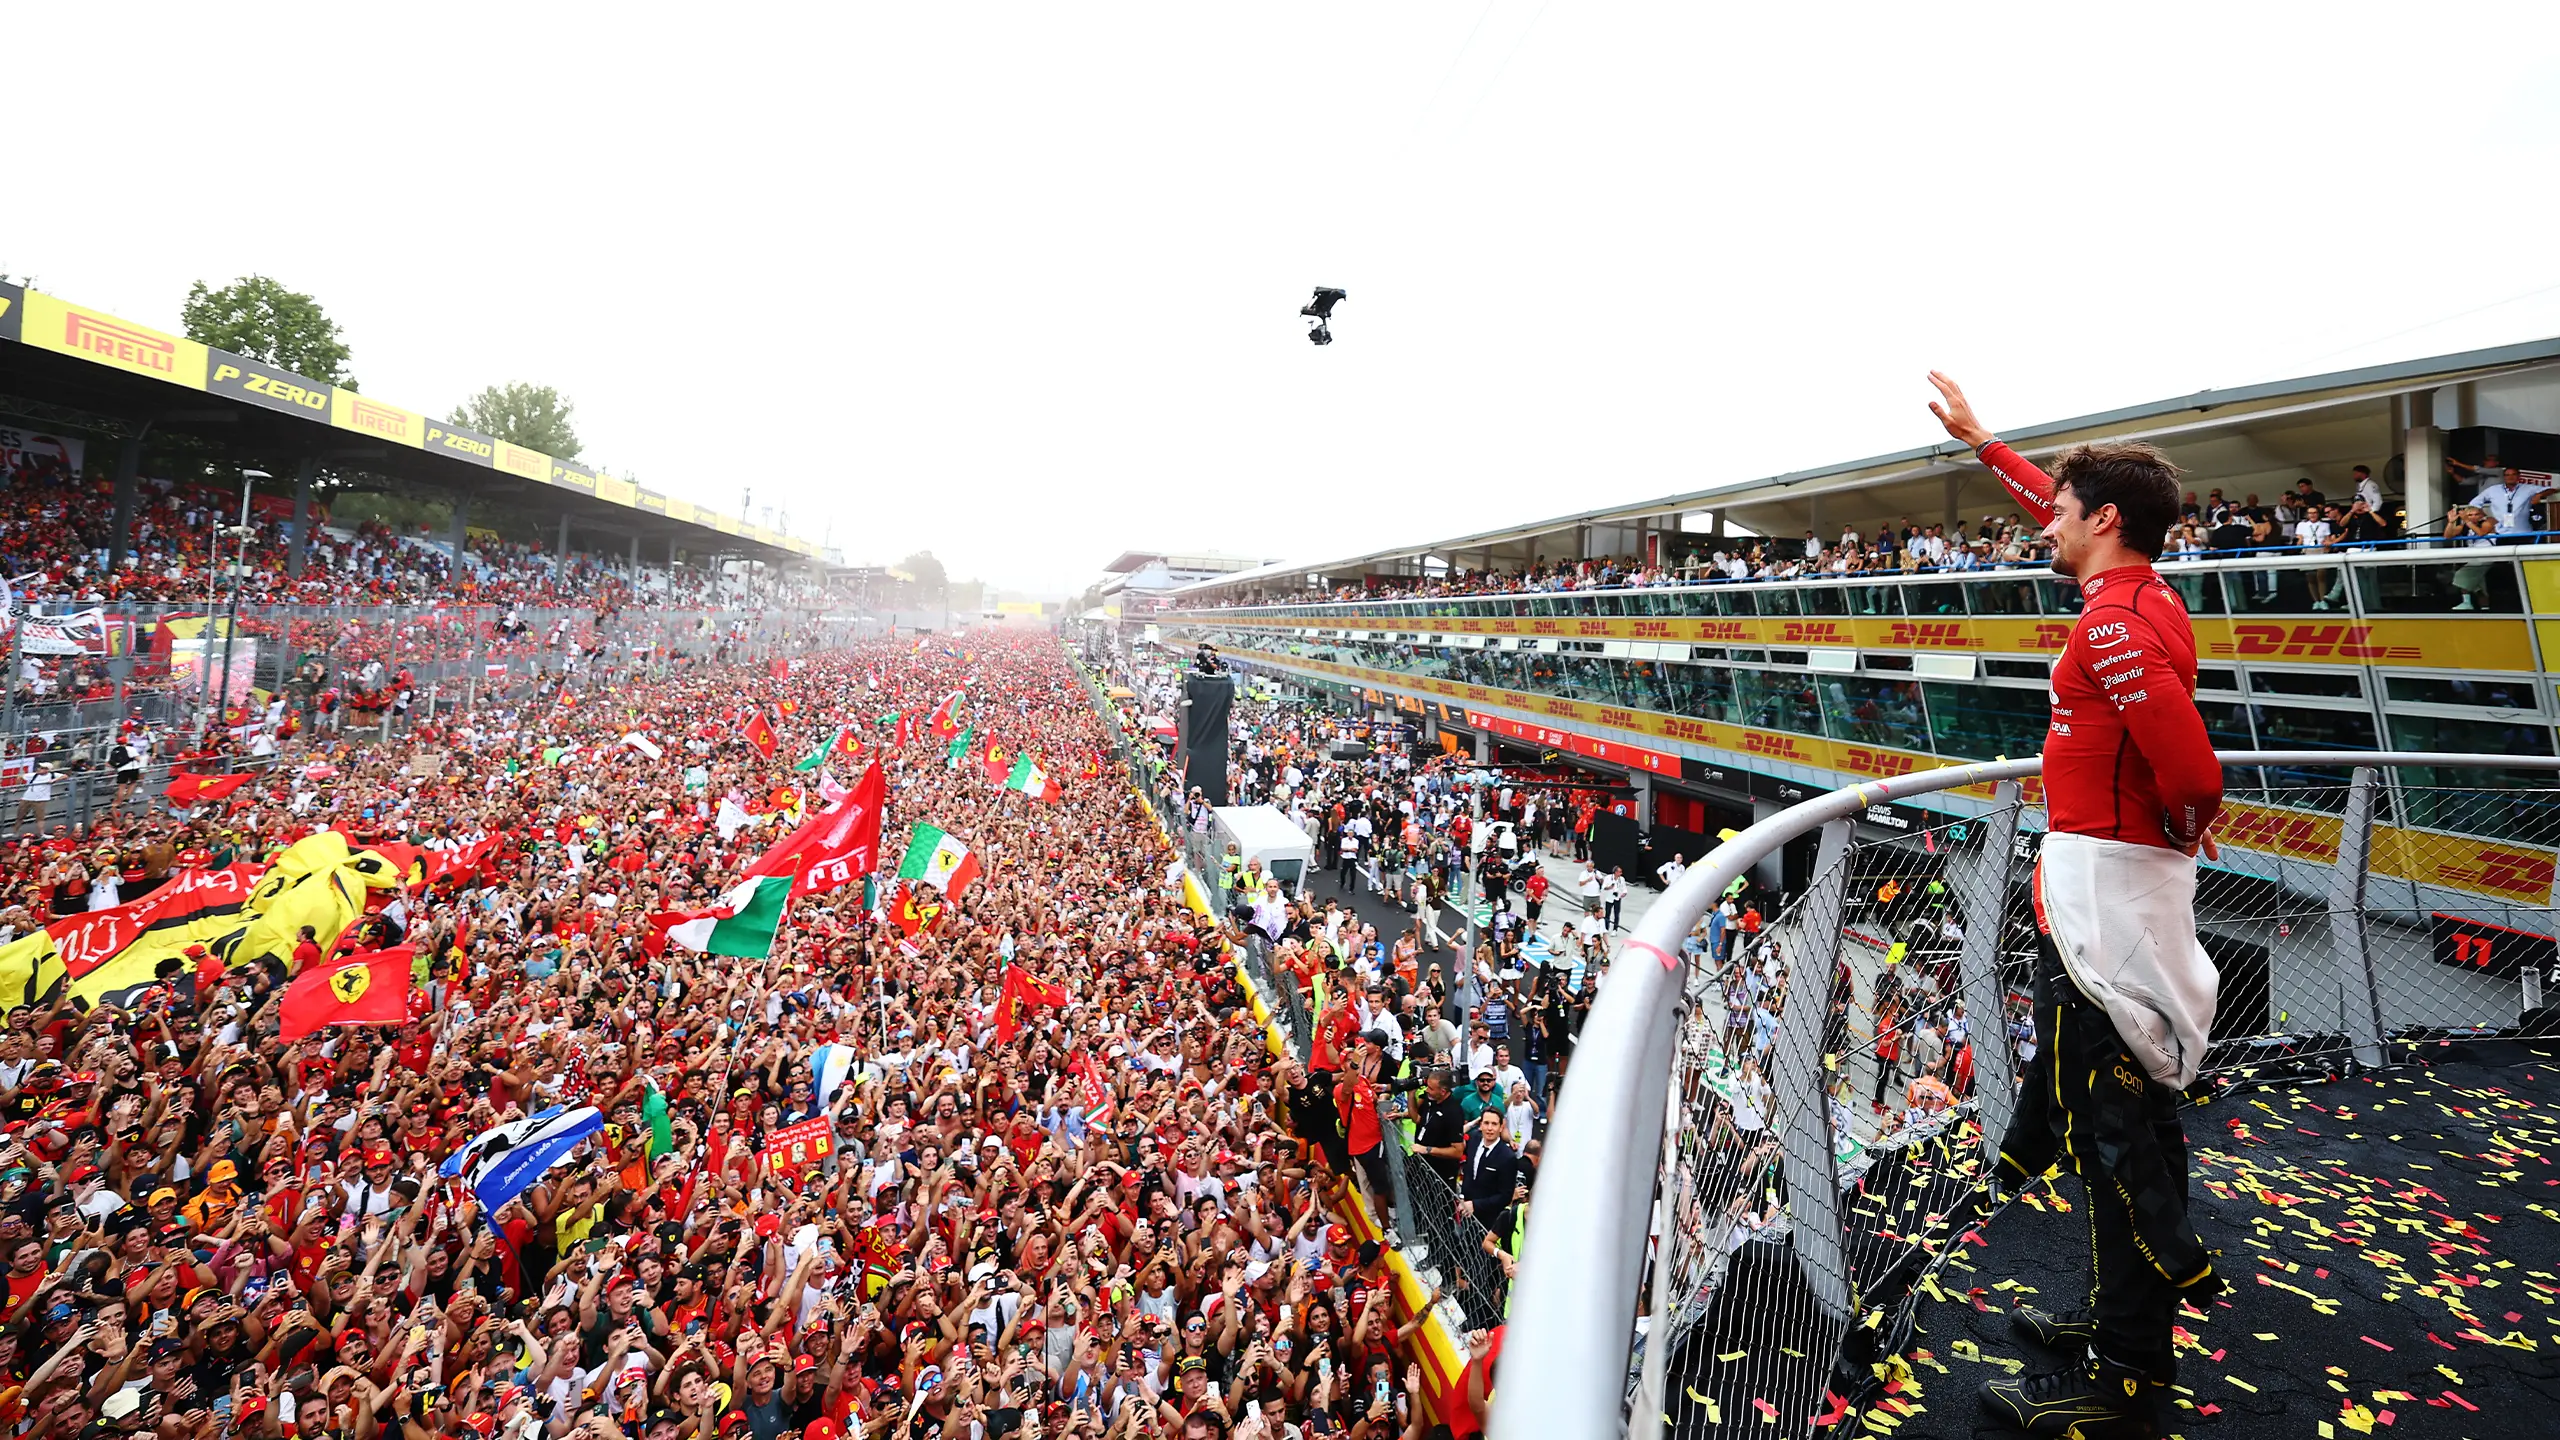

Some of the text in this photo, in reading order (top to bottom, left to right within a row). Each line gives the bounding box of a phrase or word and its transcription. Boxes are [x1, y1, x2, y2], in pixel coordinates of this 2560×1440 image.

[66, 311, 175, 373] PIRELLI
[213, 363, 328, 411] P ZERO
[352, 400, 407, 438] PIRELLI
[426, 428, 492, 459] P ZERO
[563, 469, 595, 489] ZERO
[1991, 464, 2050, 509] RICHARD MILLE
[1534, 621, 1558, 634] DHL
[1580, 621, 1612, 635] DHL
[1634, 622, 1673, 638] DHL
[1700, 622, 1748, 640] DHL
[1784, 623, 1844, 642] DHL
[1890, 623, 1971, 646] DHL
[2087, 622, 2127, 641] aws
[2233, 625, 2388, 657] DHL
[2092, 650, 2143, 672] Bitdefender
[2107, 665, 2145, 687] Palantir
[1549, 701, 1578, 718] DHL
[1600, 709, 1637, 730] DHL
[1662, 719, 1709, 742] DHL
[2052, 722, 2071, 733] CEVA
[1743, 732, 1801, 759] DHL
[1847, 750, 1913, 776] DHL
[1866, 812, 1908, 829] HAMILTON
[1950, 825, 1968, 841] 63
[2452, 933, 2493, 967] 11
[2114, 1065, 2143, 1092] apm
[2092, 1250, 2100, 1275] AND
